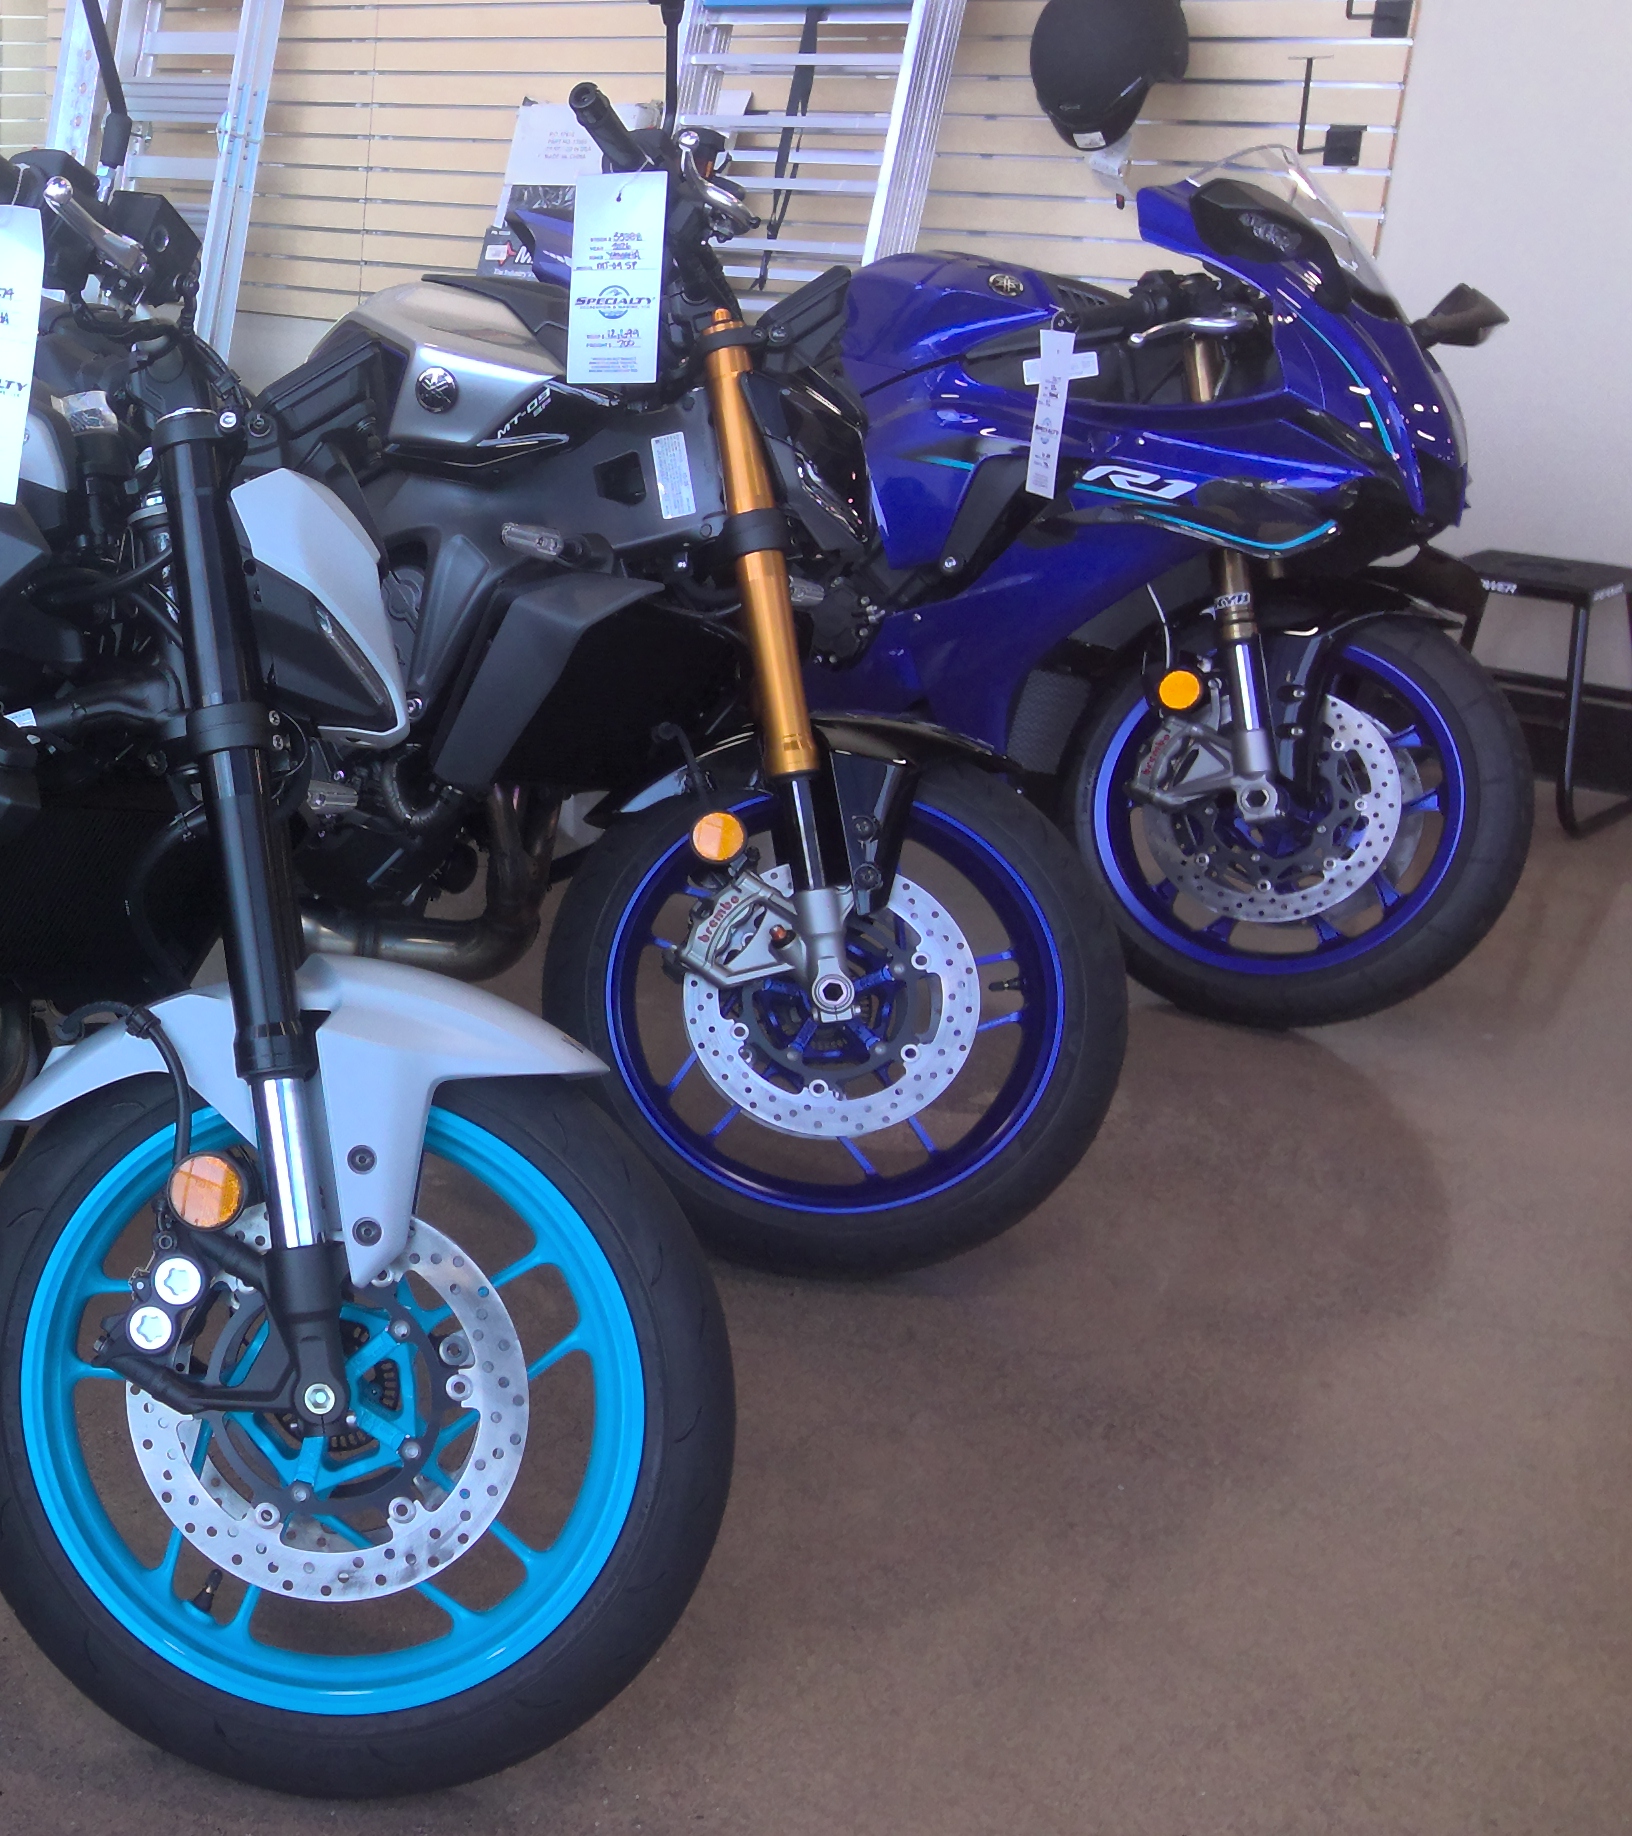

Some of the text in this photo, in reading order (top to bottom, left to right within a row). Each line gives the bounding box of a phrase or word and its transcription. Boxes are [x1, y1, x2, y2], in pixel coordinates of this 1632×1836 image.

[574, 296, 656, 306] SPECIALTY
[497, 387, 551, 440] MT-09
[1081, 465, 1198, 500] R1
[1141, 734, 1171, 775] brembo
[697, 895, 740, 943] brembo
